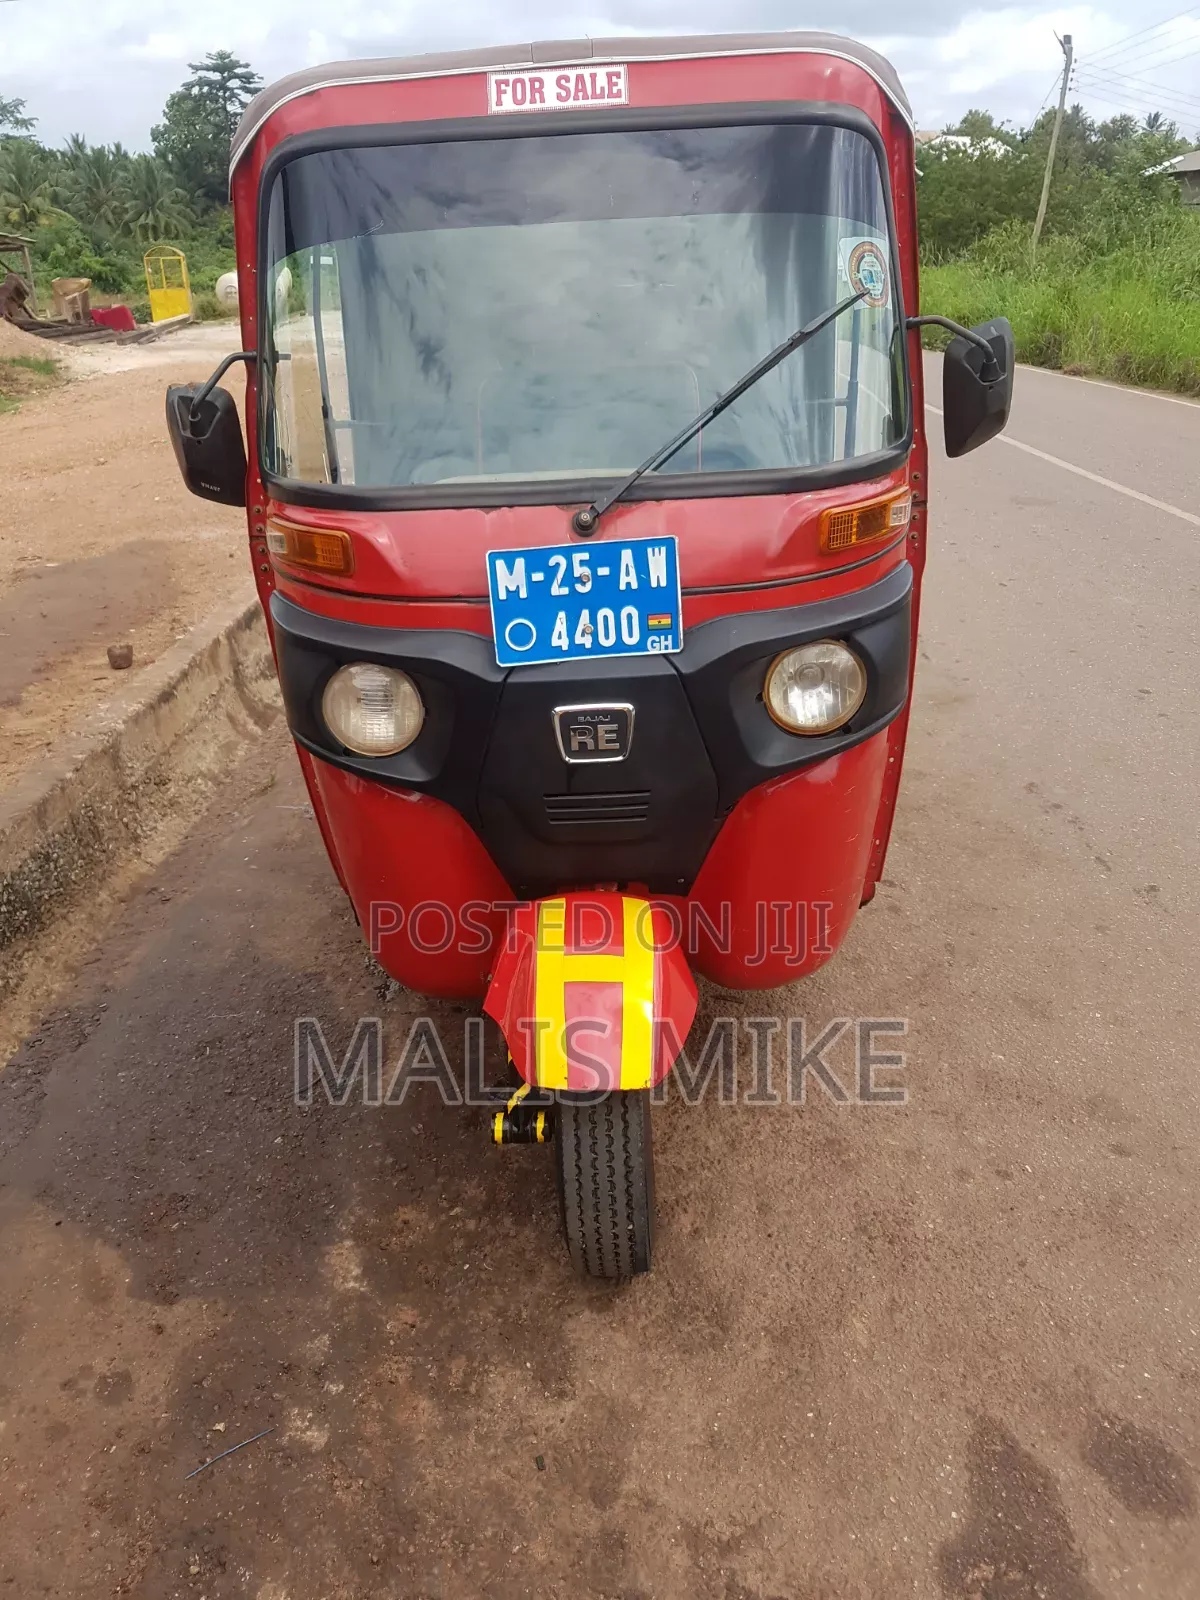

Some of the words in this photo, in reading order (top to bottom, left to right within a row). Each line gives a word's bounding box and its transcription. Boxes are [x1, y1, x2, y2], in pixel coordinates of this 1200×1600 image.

[495, 77, 545, 106] FOR
[556, 71, 622, 103] SALE
[551, 604, 640, 651] 4400
[647, 634, 673, 651] GH
[577, 714, 611, 722] BAJAJ
[569, 723, 620, 751] RE
